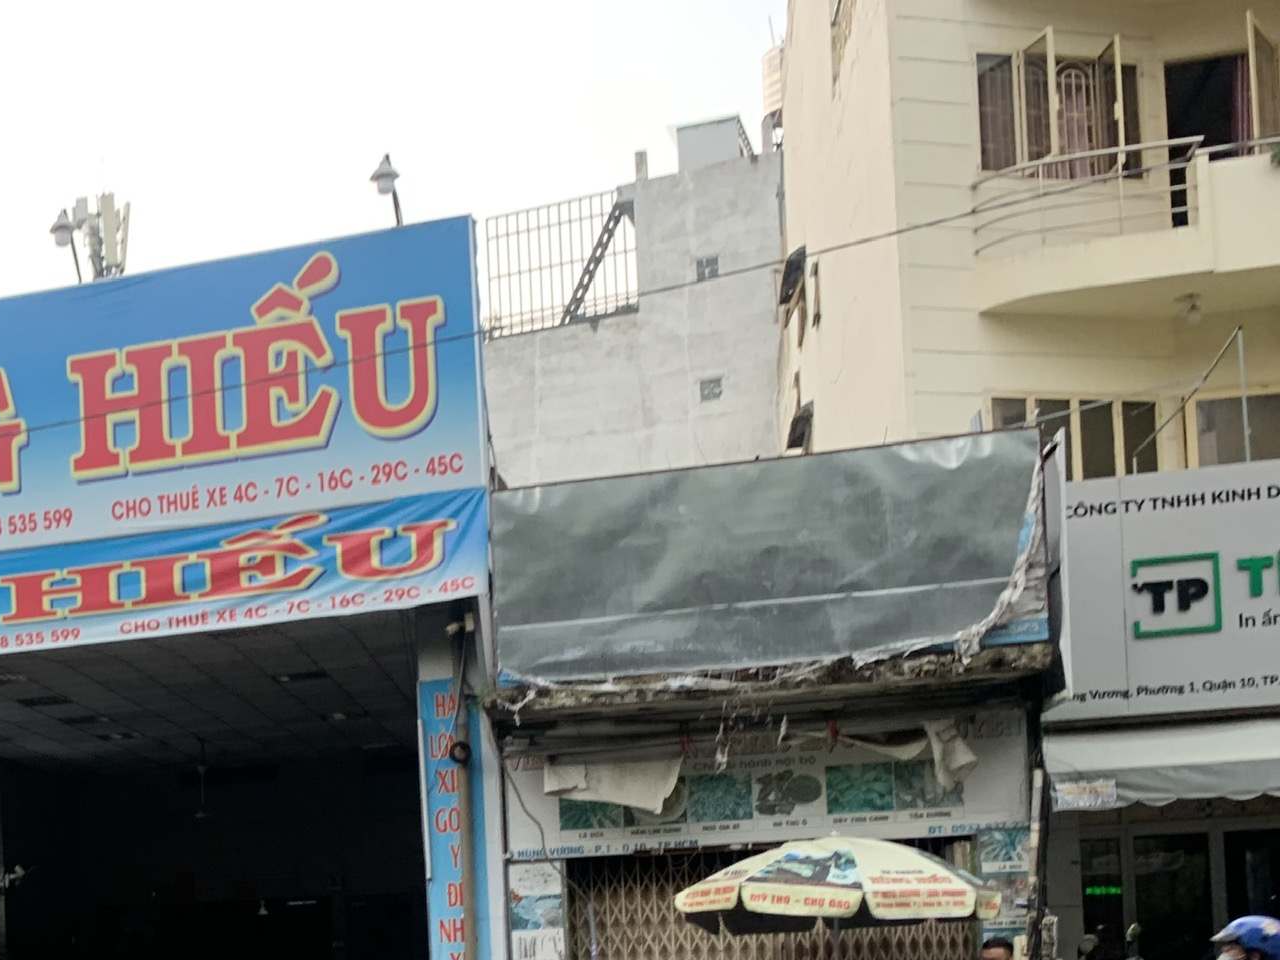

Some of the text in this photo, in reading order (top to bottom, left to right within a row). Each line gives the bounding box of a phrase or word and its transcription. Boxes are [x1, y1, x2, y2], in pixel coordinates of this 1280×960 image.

[67, 250, 446, 483] HIẾU
[112, 452, 464, 521] CHO THUÊ XE 4C 7C 16C 29C 45C
[1121, 498, 1145, 513] TY
[1147, 492, 1205, 511] TNHH
[1211, 487, 1261, 504] KINH
[8, 512, 38, 536] 535
[43, 508, 73, 529] 599
[1236, 549, 1280, 598] T
[120, 575, 476, 634] CHO THUÊ XE 4C 7C 16C 29C 45C
[1138, 578, 1210, 615] TP
[1238, 613, 1256, 629] In
[15, 632, 45, 646] 535
[50, 627, 81, 641] 599
[1072, 692, 1087, 702] ng
[1202, 680, 1236, 693] Quận
[434, 799, 461, 834] GÓ
[750, 892, 767, 902] MỸ
[771, 893, 790, 905] THO
[439, 918, 465, 944] NH
